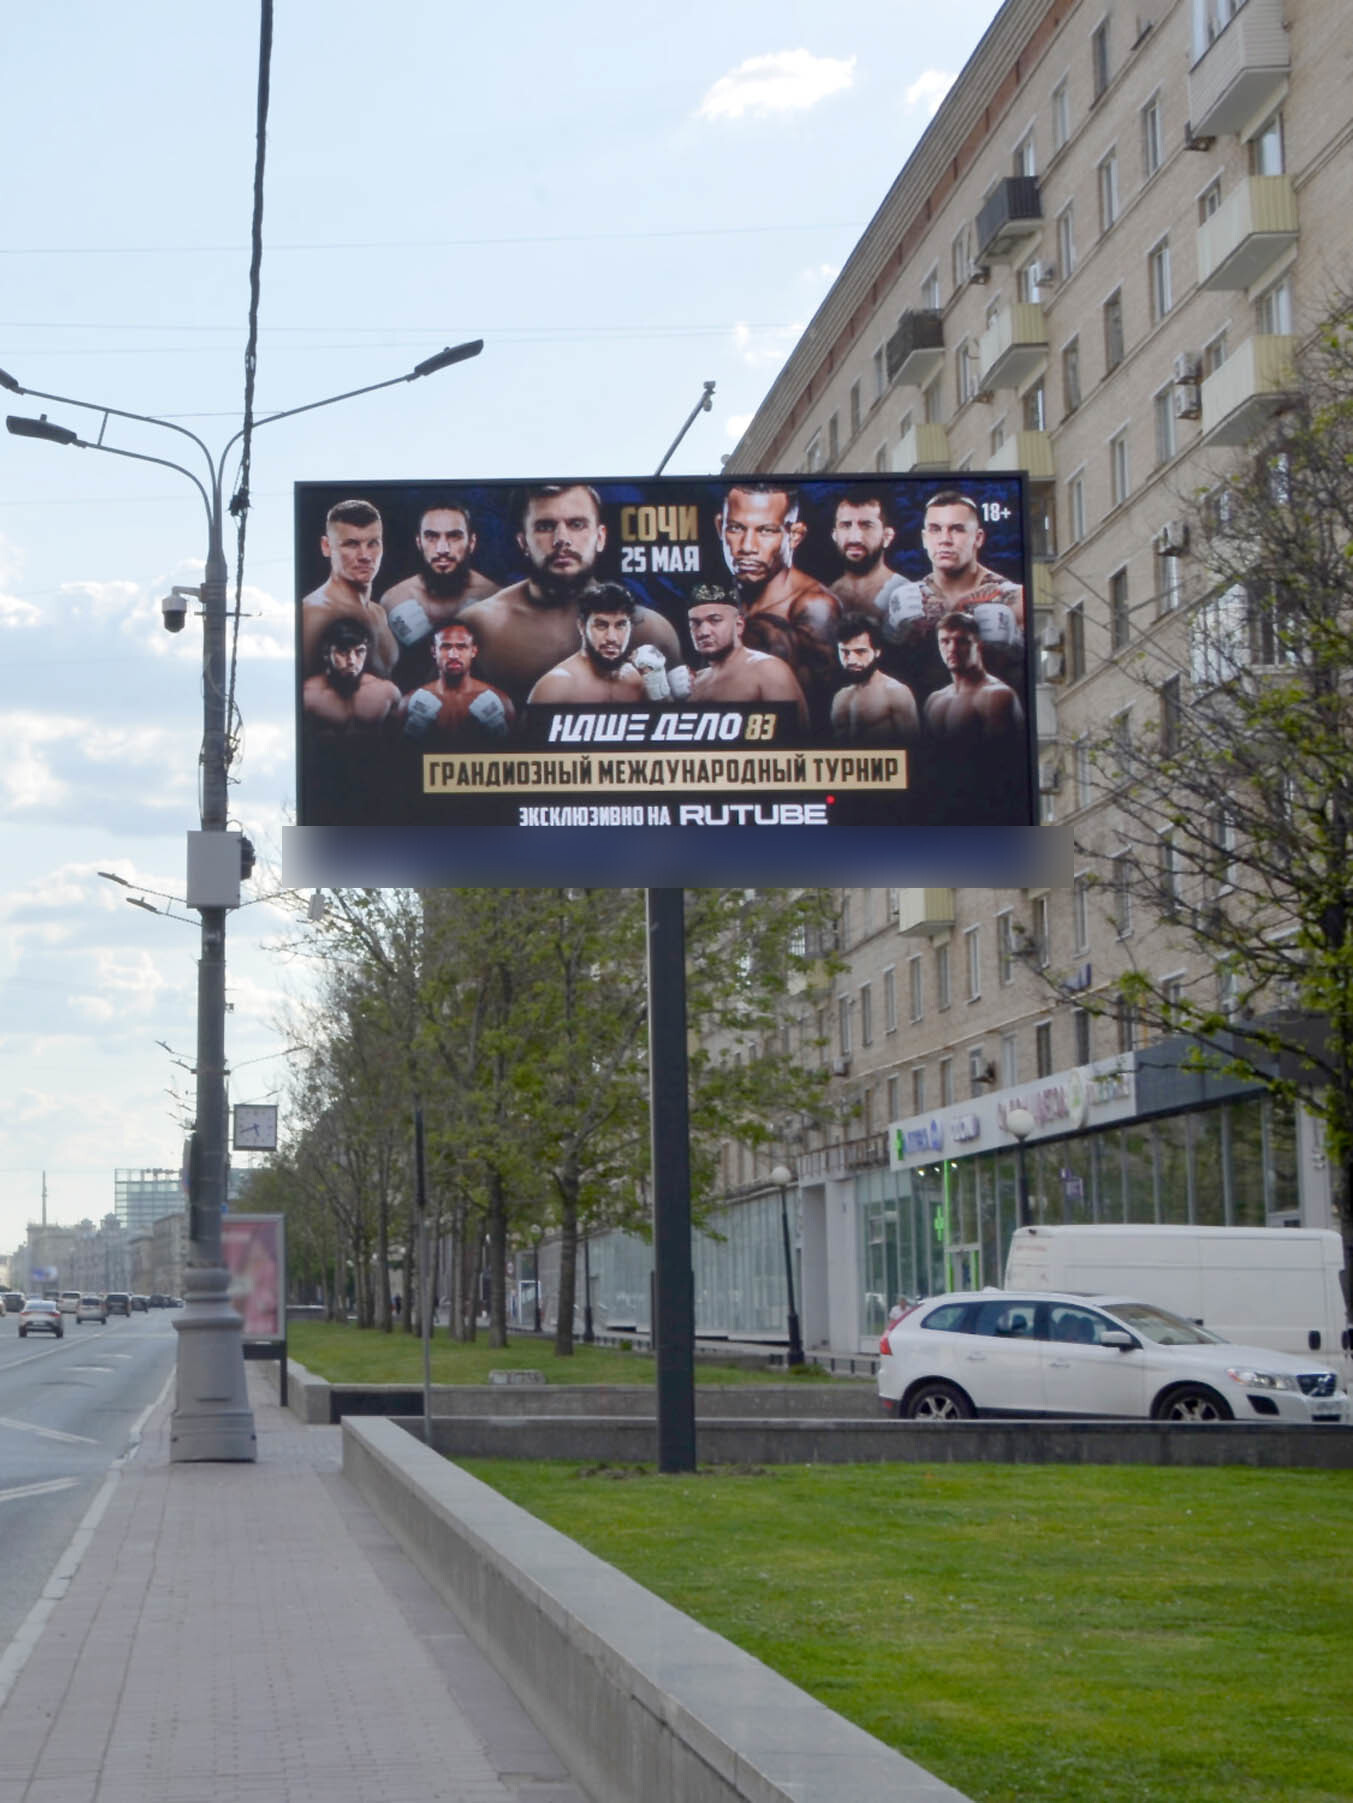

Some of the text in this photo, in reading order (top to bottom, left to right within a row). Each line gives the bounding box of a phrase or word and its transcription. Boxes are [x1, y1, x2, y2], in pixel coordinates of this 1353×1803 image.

[621, 505, 698, 541] СОЧИ
[981, 502, 1012, 522] 18+
[621, 545, 700, 573] 25 МАЯ
[548, 713, 777, 742] НАШЕ ДЕЛО 83
[429, 753, 899, 787] ГРАНДИОЗНЫЙ МЕЖДУНАРОДНЫЙ ТУРНИР
[519, 804, 829, 827] ЭКСКЛЮЗИВНО НА RUTUBE
